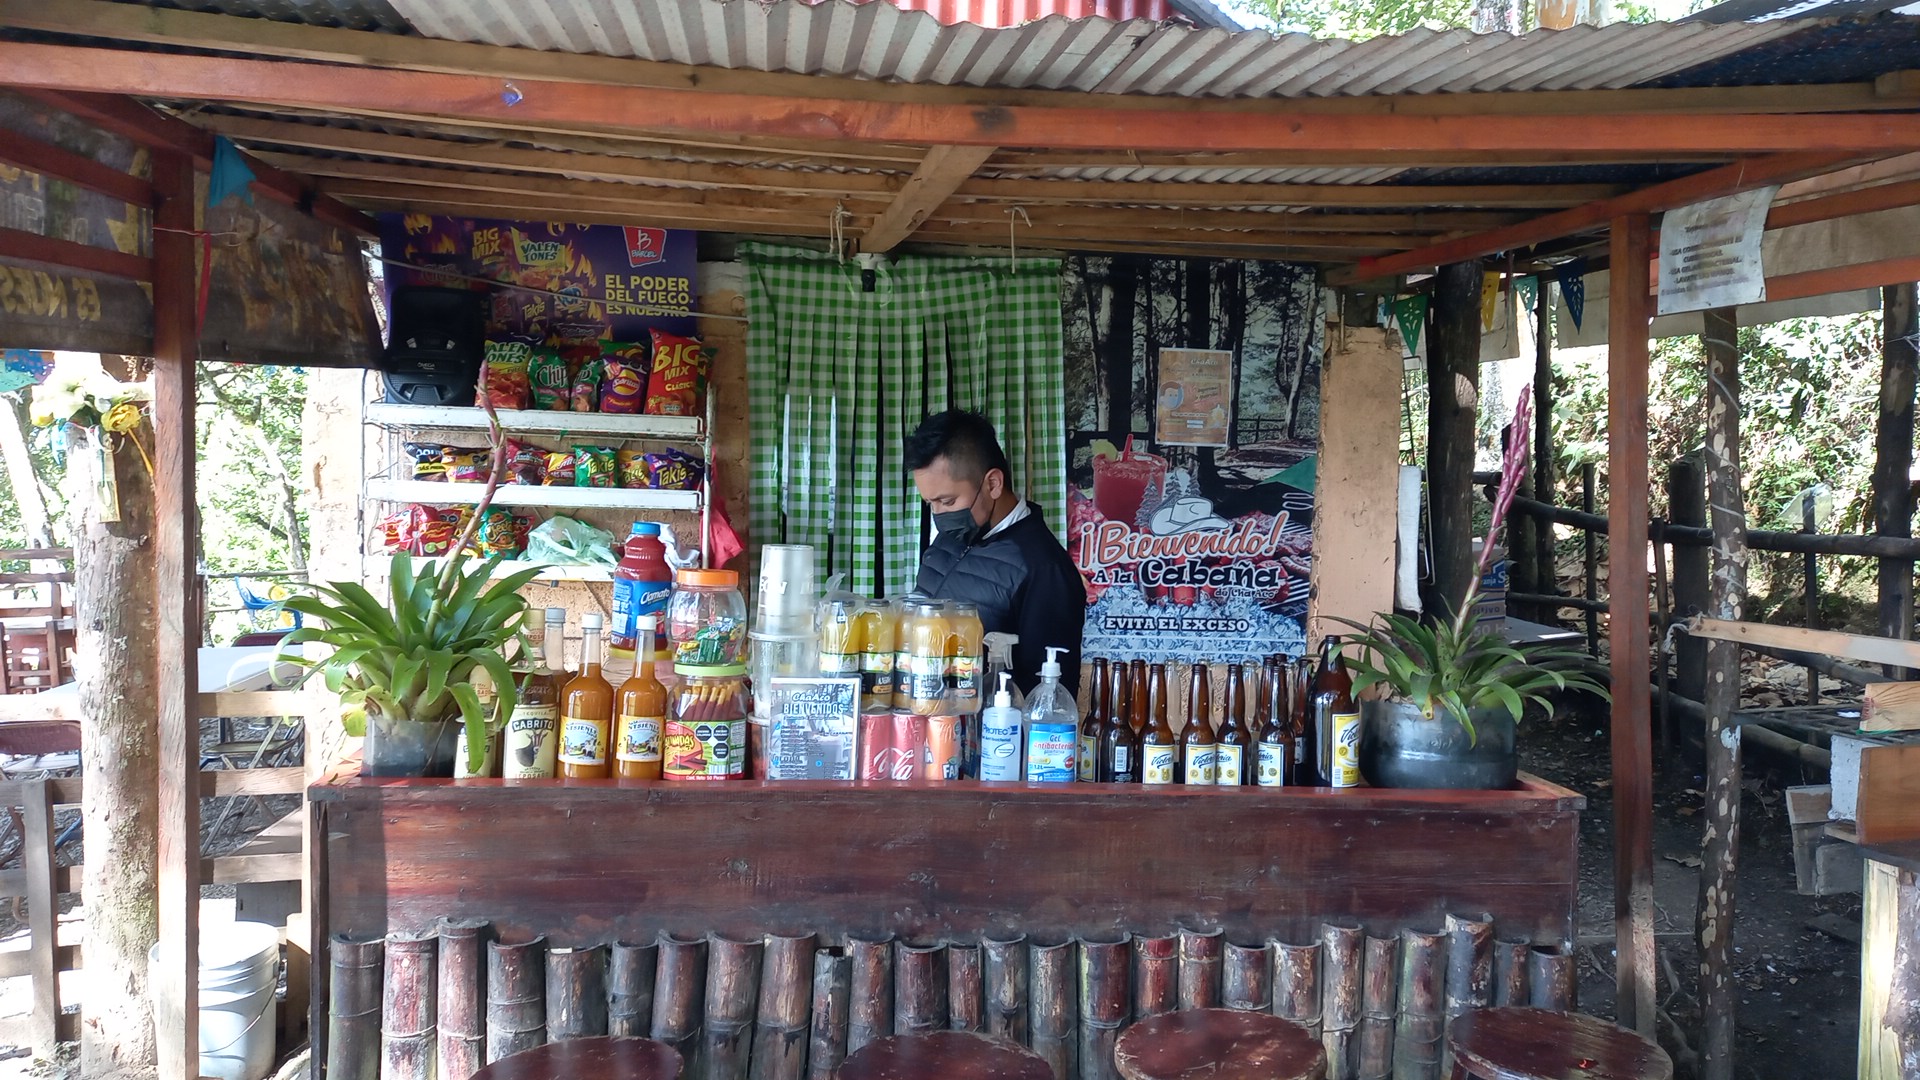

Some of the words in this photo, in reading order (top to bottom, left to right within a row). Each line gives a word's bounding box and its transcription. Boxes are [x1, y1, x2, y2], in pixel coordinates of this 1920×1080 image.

[473, 227, 499, 246] BIG
[472, 239, 500, 260] MIX
[523, 252, 558, 263] TONES
[605, 274, 625, 289] EL
[630, 275, 690, 292] PODER
[605, 289, 634, 303] DEL
[638, 290, 690, 305] FUEGO
[606, 303, 623, 315] ES
[625, 302, 690, 318] NUESTRO
[488, 342, 531, 354] ALEN
[487, 352, 528, 364] ONES
[653, 343, 701, 374] BIG
[664, 365, 690, 380] MIX
[585, 457, 615, 478] Takis
[656, 465, 687, 487] Takis
[1081, 511, 1288, 568] ¡Bienvenido!
[1093, 570, 1108, 583] A
[1113, 570, 1133, 583] la
[1141, 559, 1279, 588] Cabaña
[640, 588, 671, 605] Clamato
[1105, 617, 1154, 630] EVITA
[1157, 618, 1179, 630] EL
[1181, 618, 1249, 631] EXCESO
[783, 703, 844, 714] BIENVENIDOS
[513, 720, 554, 731] CABRITO
